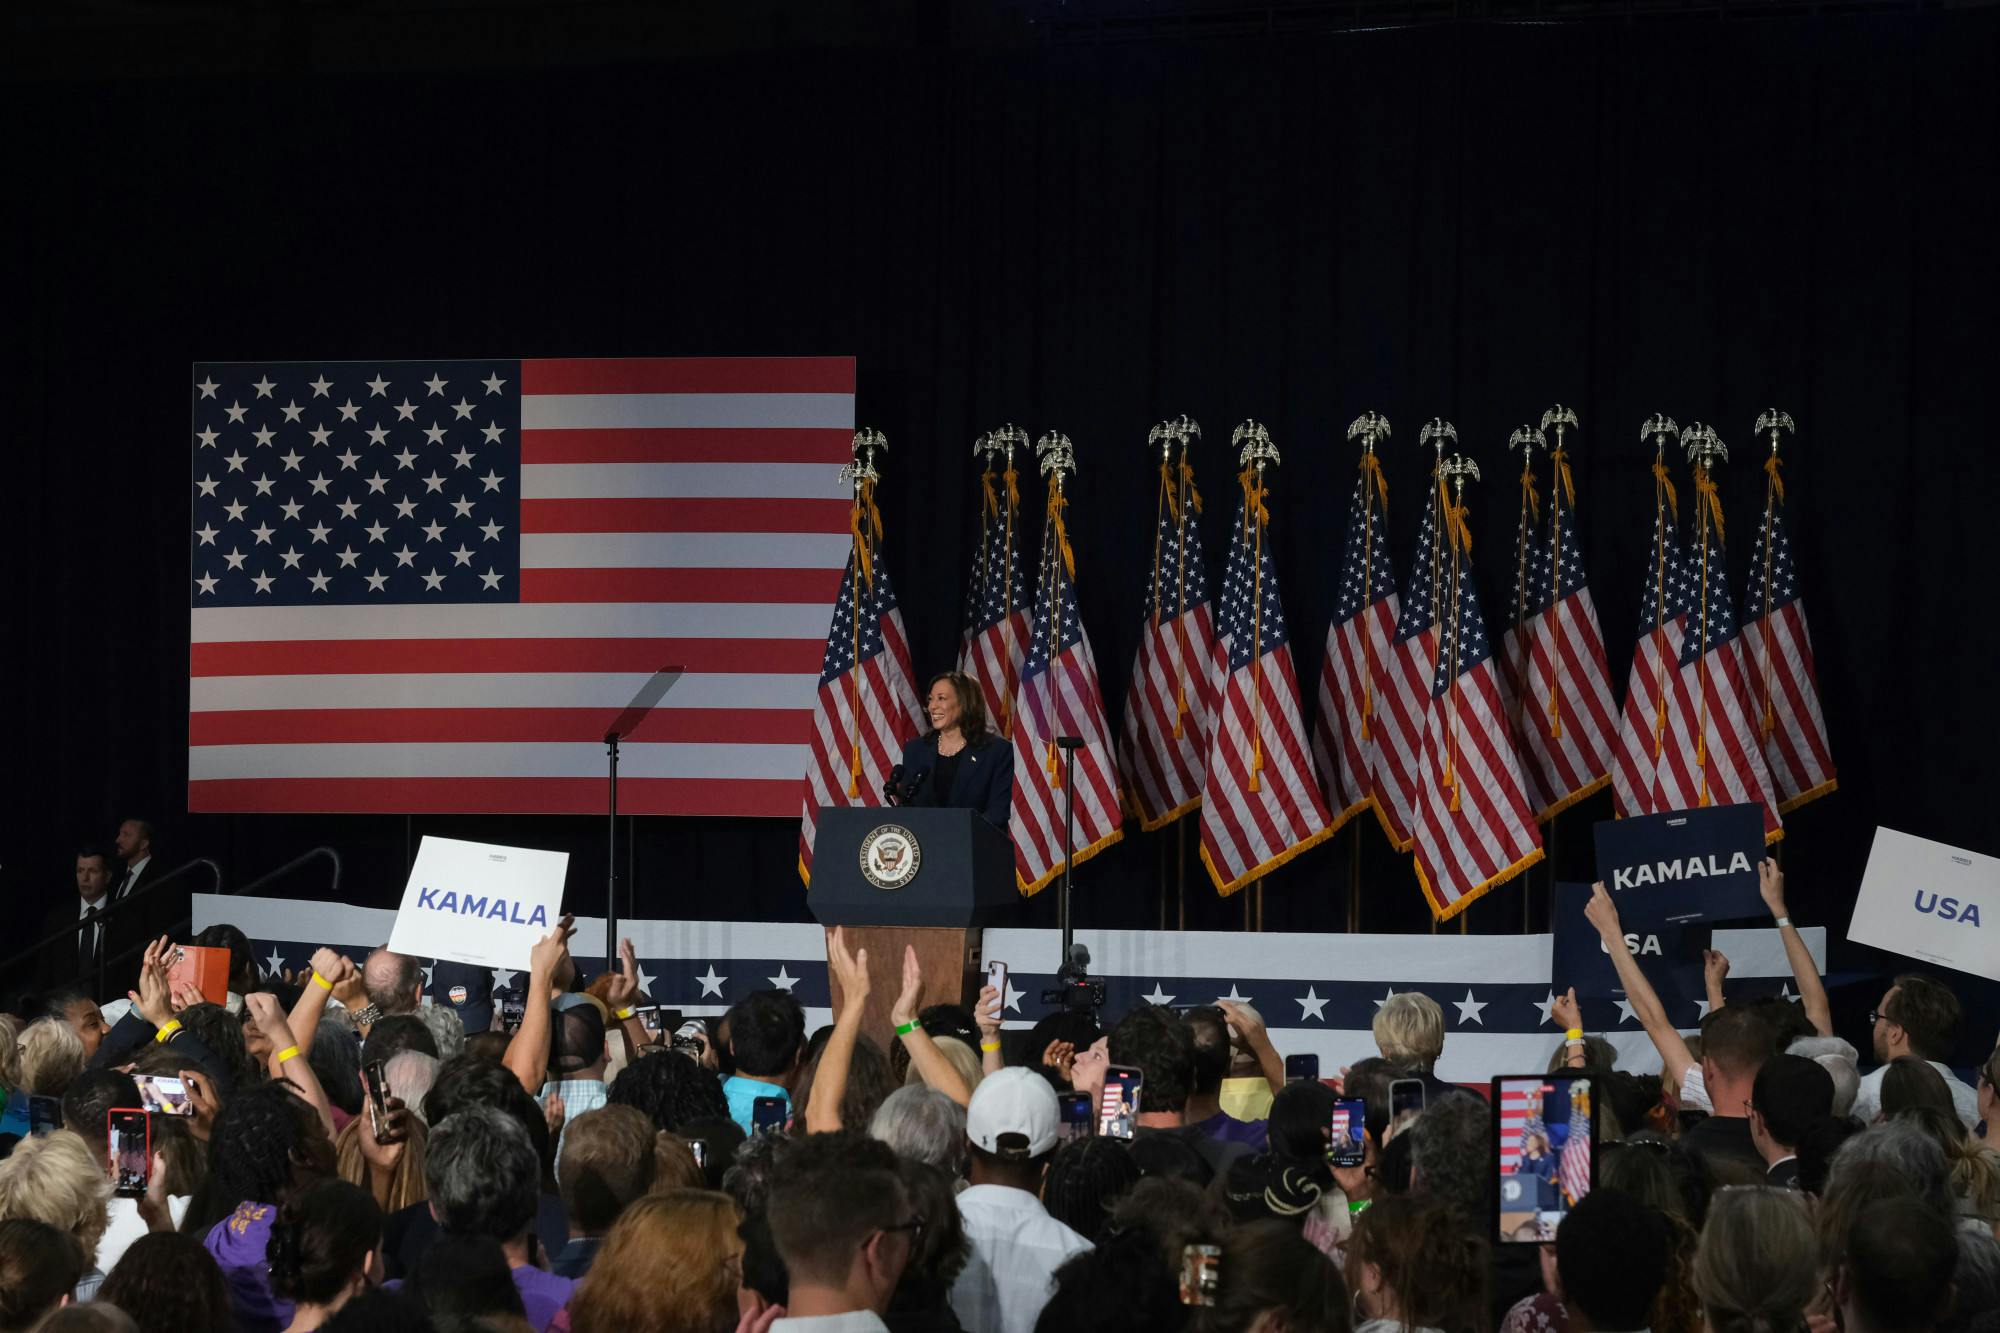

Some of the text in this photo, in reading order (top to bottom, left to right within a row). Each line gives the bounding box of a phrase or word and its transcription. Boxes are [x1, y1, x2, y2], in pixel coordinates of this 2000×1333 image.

[861, 831, 878, 868] PRESIDENT
[903, 830, 919, 857] UNITED
[866, 871, 880, 885] VICE
[900, 862, 919, 885] STATES
[1613, 852, 1752, 890] KAMALA
[417, 887, 547, 927] KAMALA
[1915, 889, 1980, 928] USA
